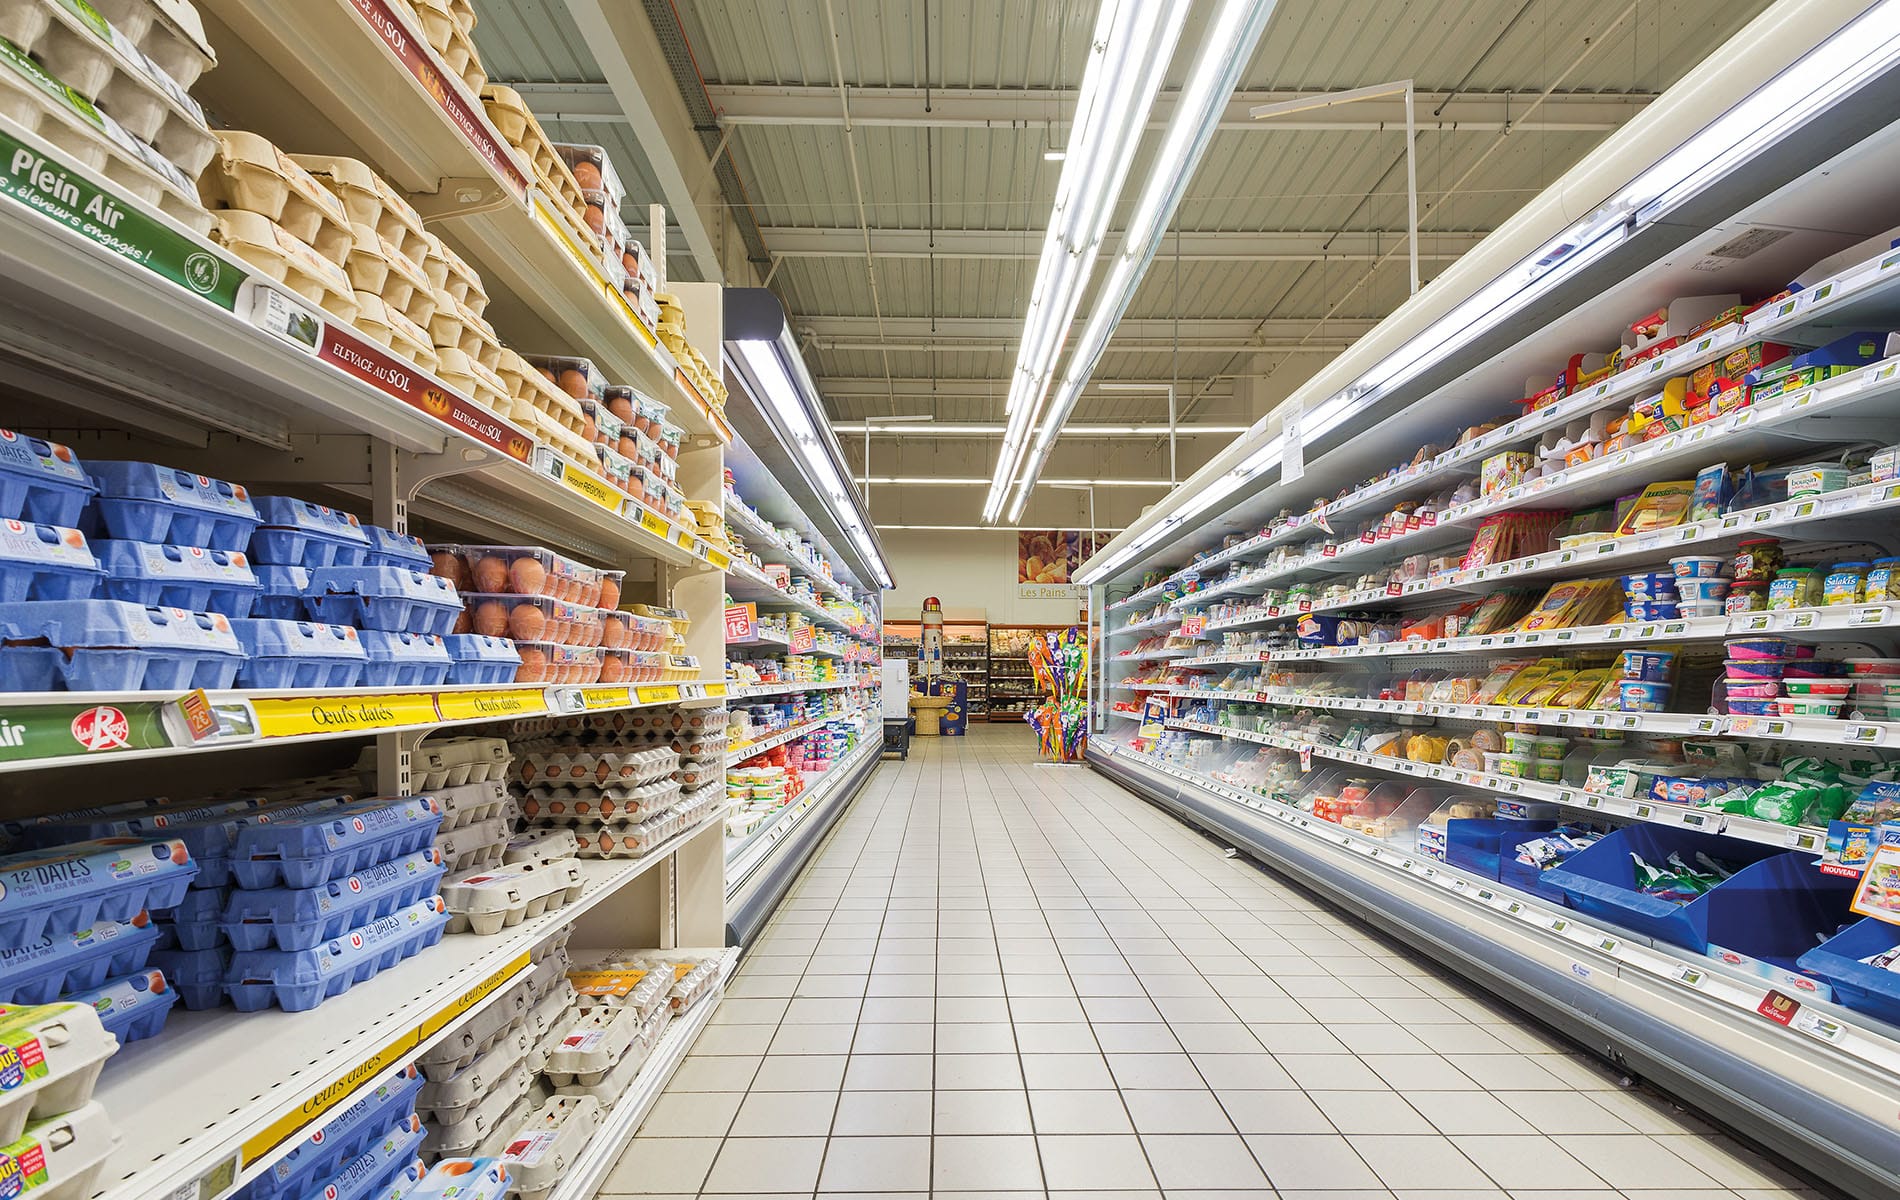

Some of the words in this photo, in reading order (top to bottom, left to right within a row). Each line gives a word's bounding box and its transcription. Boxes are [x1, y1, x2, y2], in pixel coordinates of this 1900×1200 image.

[384, 21, 407, 57] SOL
[448, 100, 474, 136] ELEVAGE
[482, 138, 497, 165] SOL
[11, 148, 80, 208] Plein
[84, 194, 125, 230] Air
[17, 185, 81, 226] éleveurs
[83, 223, 143, 261] engagés
[332, 342, 375, 374] ELEVAGE
[373, 366, 388, 381] AU
[386, 368, 410, 393] SOL
[452, 408, 479, 429] ELEVAGE
[477, 422, 488, 435] AU
[486, 424, 502, 443] SOL
[1771, 580, 1795, 591] Salakis
[1826, 575, 1857, 587] Salakis
[1021, 588, 1037, 598] Les
[1040, 588, 1066, 598] Pains
[728, 620, 749, 636] 1€
[1188, 624, 1200, 634] 1€
[796, 639, 810, 649] 2€
[474, 696, 499, 713] Œufs
[500, 694, 522, 710] datés
[192, 710, 209, 730] 2€
[311, 704, 356, 726] Œufs
[358, 703, 394, 723] datés
[353, 821, 363, 832] U
[11, 870, 33, 884] 12
[361, 870, 372, 880] 12
[1823, 865, 1857, 877] NOUVEAU
[349, 879, 360, 891] U
[351, 935, 361, 946] U
[1772, 995, 1792, 1012] U
[0, 1048, 21, 1072] UE
[0, 1157, 21, 1181] UE
[326, 1186, 336, 1199] U
